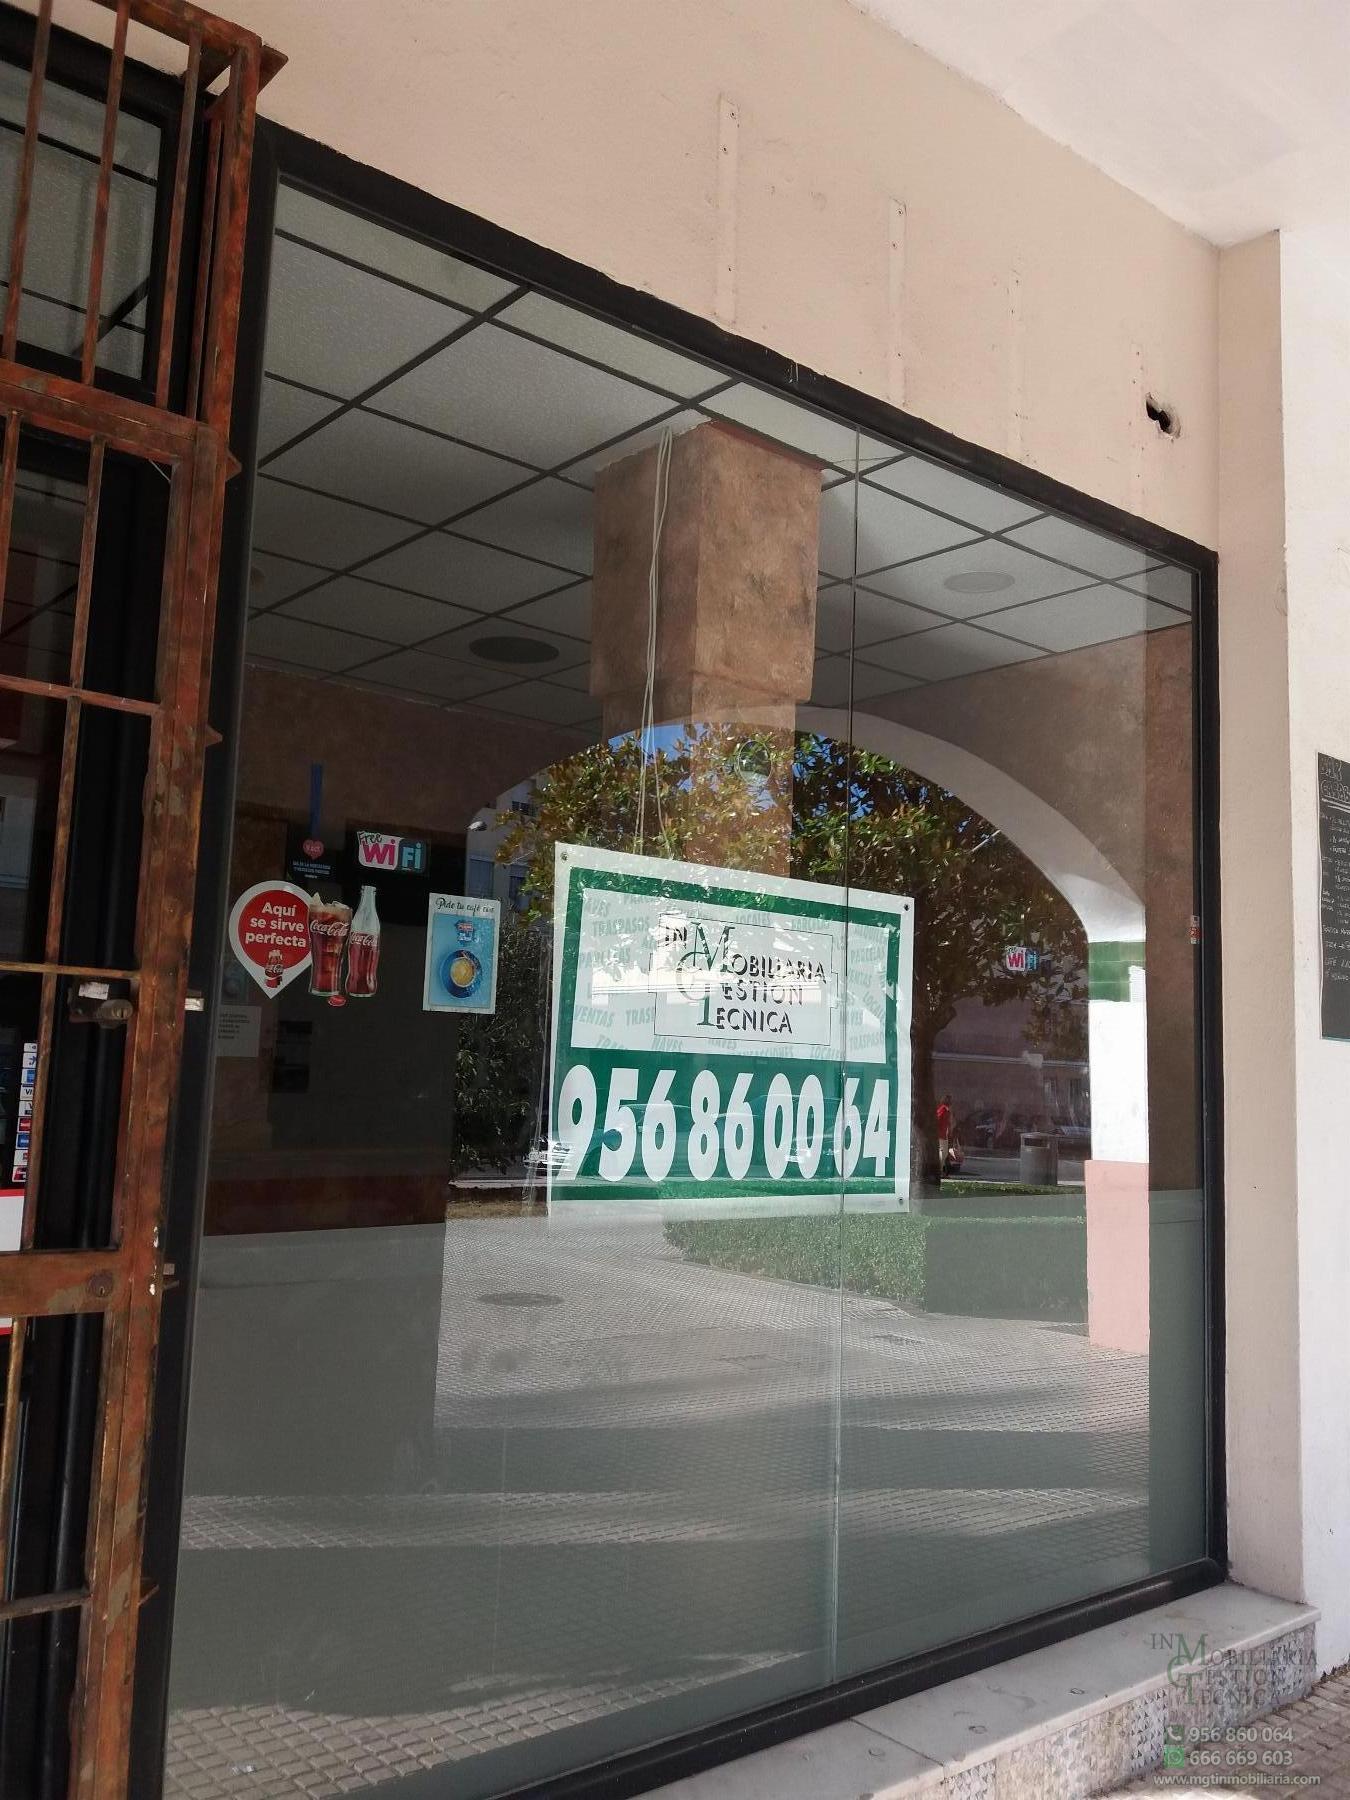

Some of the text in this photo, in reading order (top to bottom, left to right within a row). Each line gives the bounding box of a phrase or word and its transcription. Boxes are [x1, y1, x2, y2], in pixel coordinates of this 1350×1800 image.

[359, 831, 382, 844] Free
[261, 901, 297, 918] Aquí
[250, 917, 305, 933] se sirve
[245, 932, 307, 948] perfecta
[574, 1004, 616, 1028] VENTAS
[556, 1065, 891, 1182] 956 86 00 64
